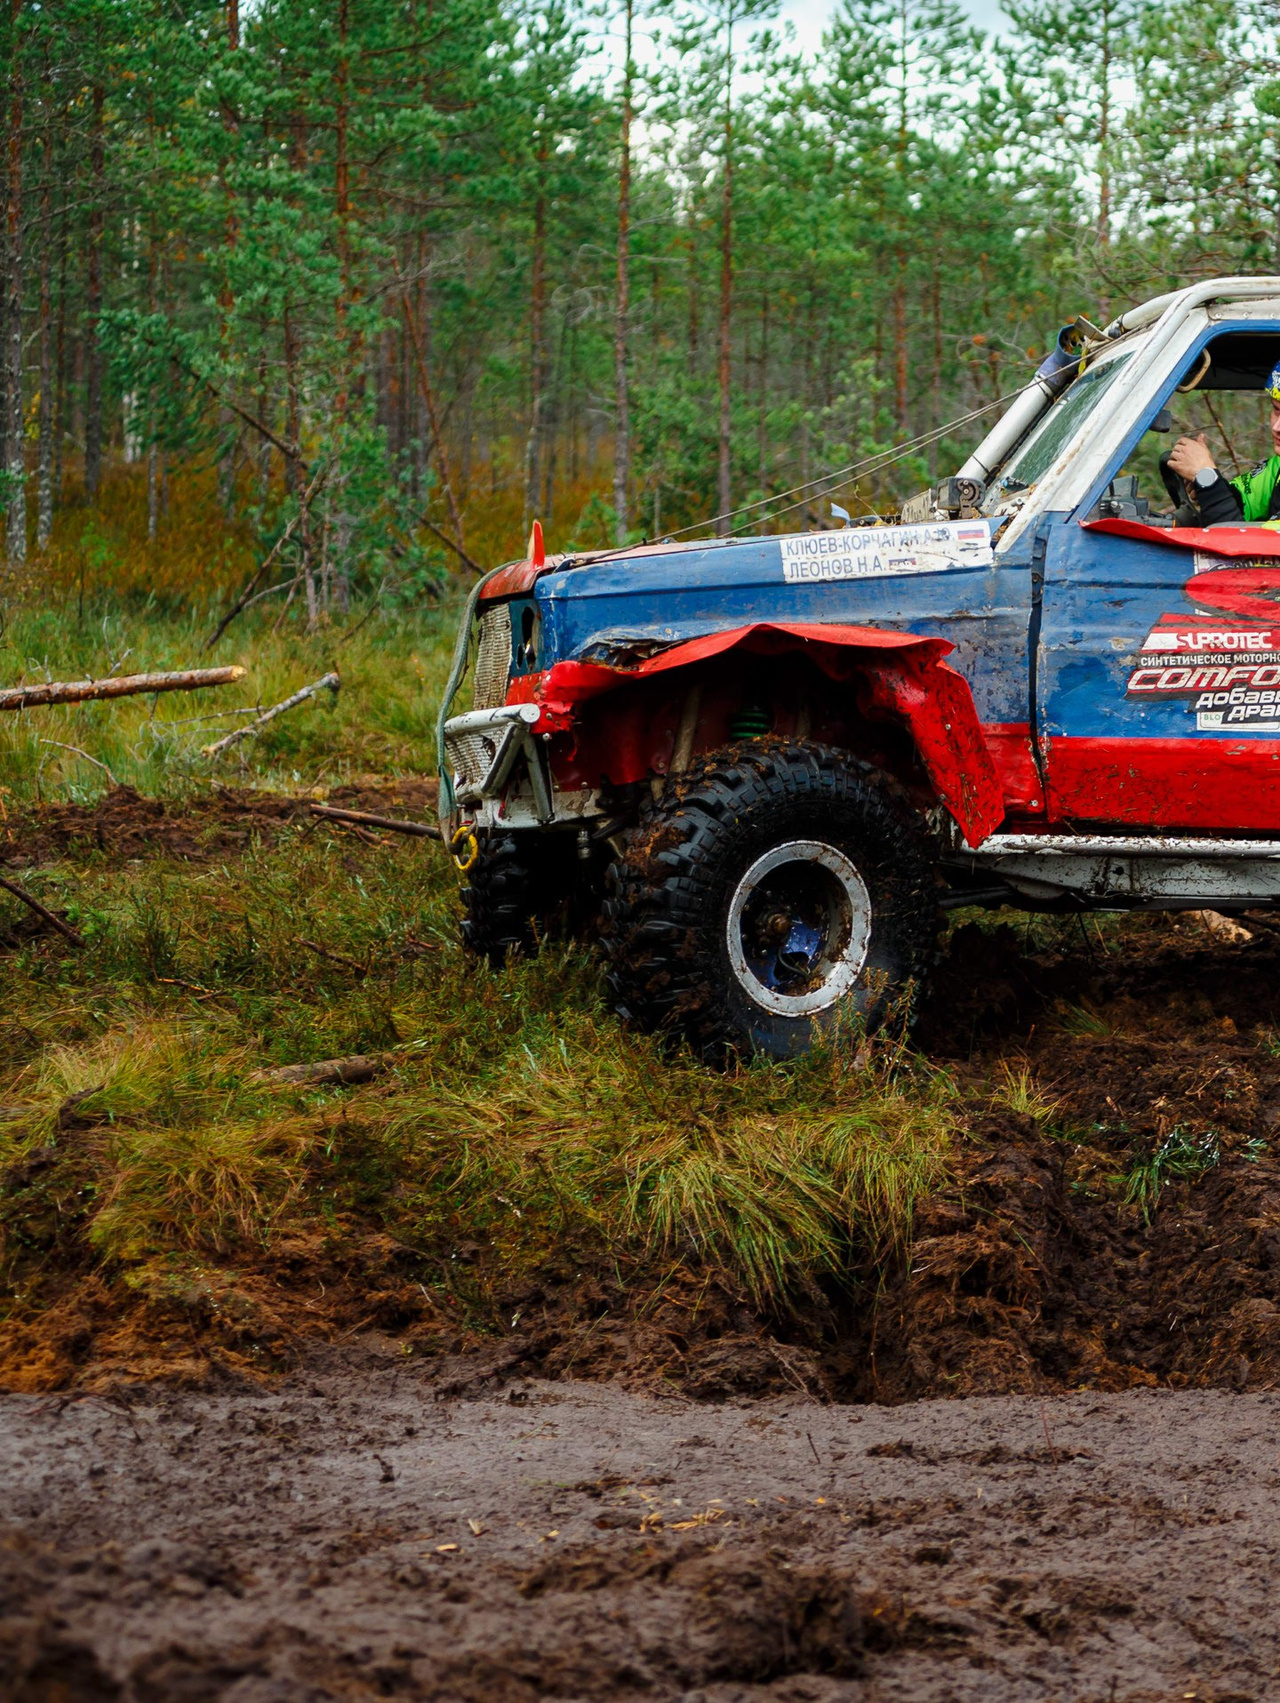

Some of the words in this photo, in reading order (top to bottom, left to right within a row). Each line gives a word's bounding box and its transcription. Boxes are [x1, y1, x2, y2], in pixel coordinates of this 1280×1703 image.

[789, 558, 853, 579] ЛЕОНОВ
[857, 556, 887, 573] Н.А.
[1175, 631, 1273, 650] SUPROTEC
[1140, 654, 1231, 667] СИНТЕТИЧЕСКОЕ
